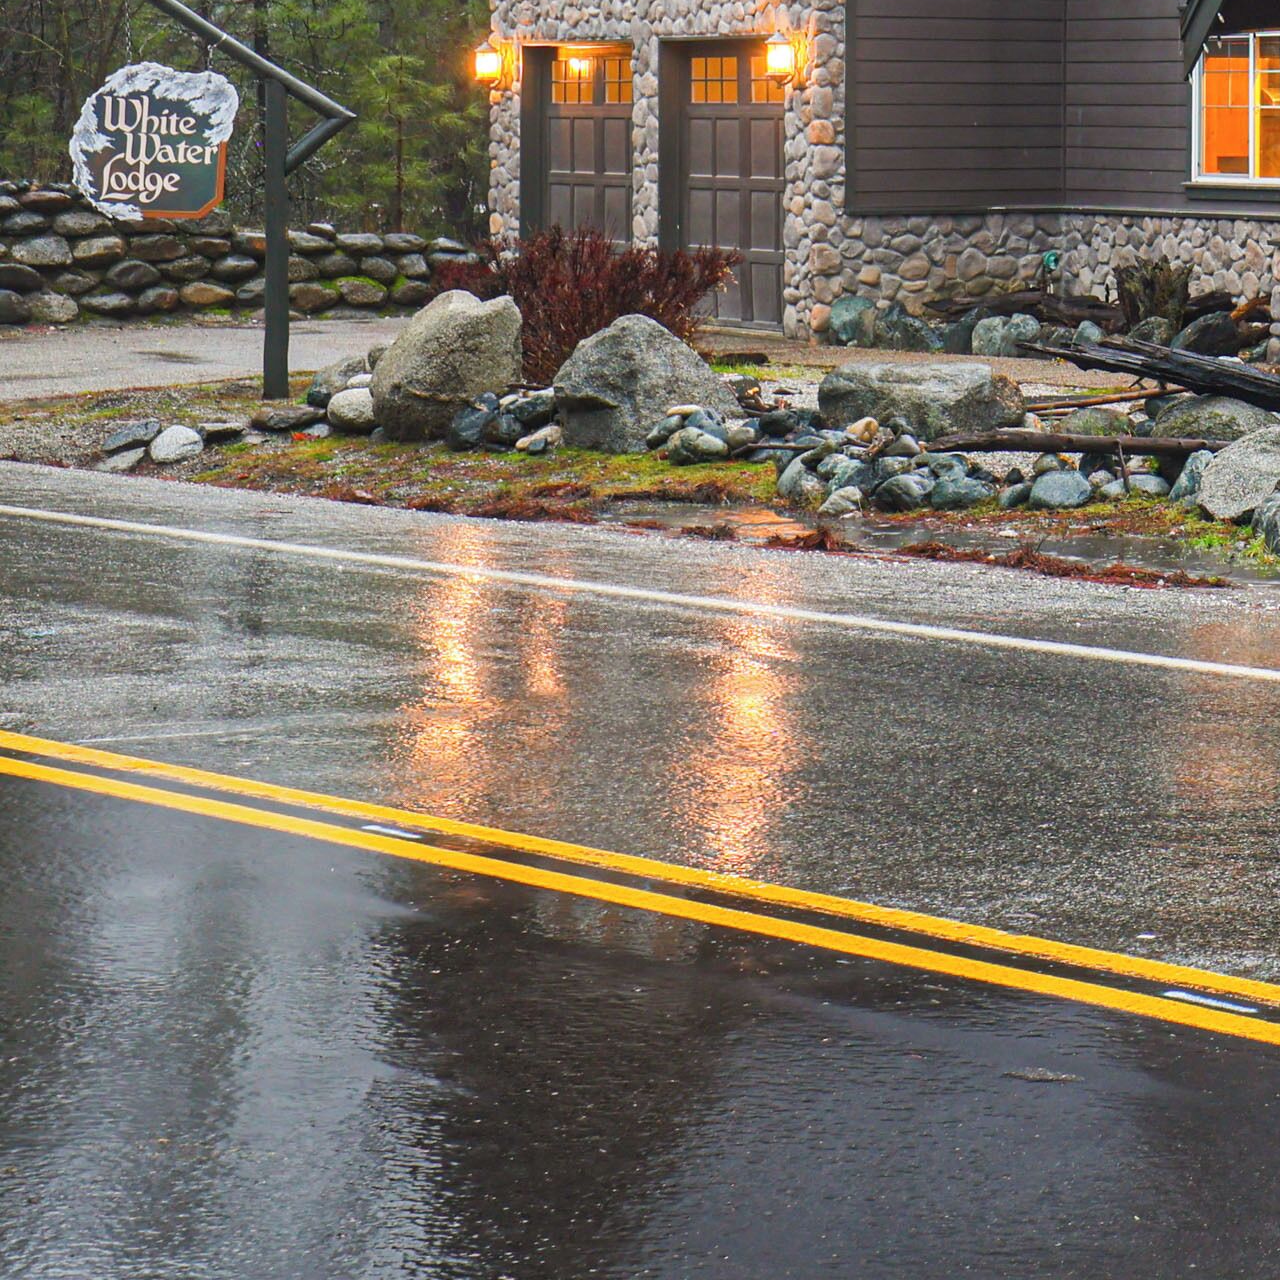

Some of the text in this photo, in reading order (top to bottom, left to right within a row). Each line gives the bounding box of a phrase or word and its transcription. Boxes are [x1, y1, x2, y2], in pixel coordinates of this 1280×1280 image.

[102, 95, 197, 136] White
[124, 131, 219, 166] Water
[100, 152, 181, 204] Lodge
